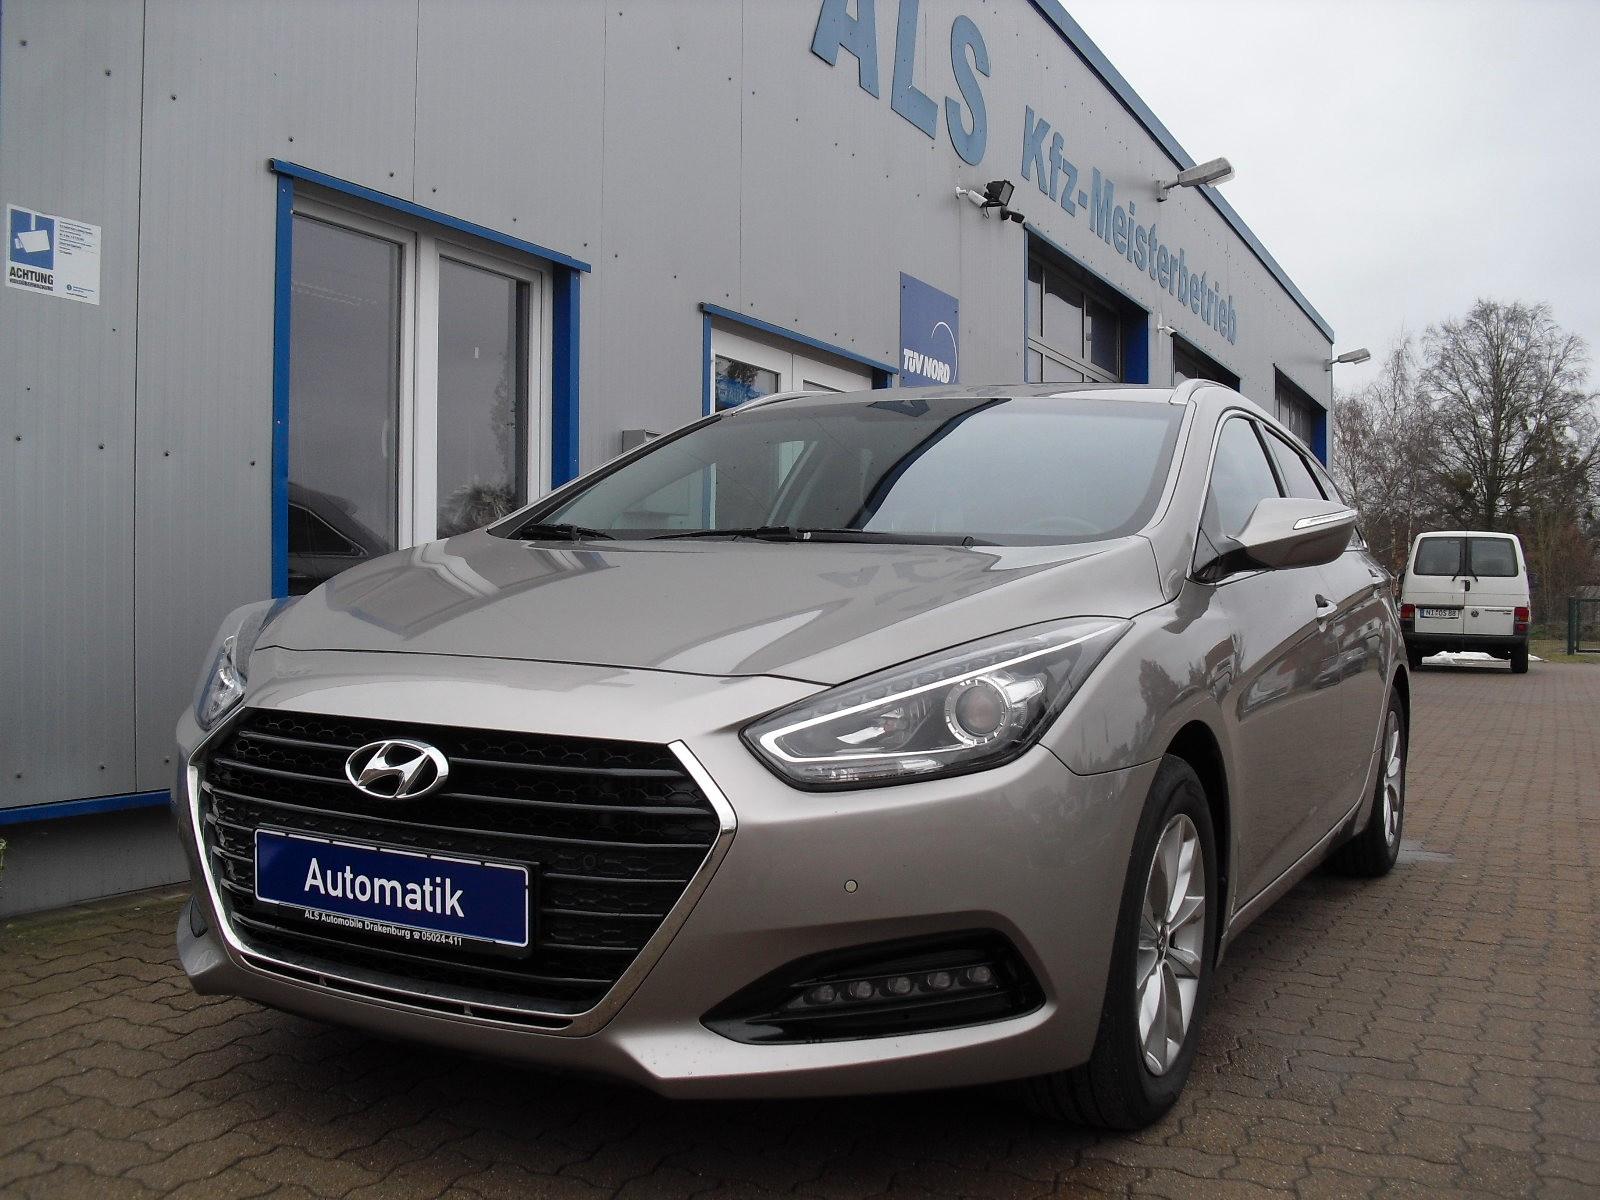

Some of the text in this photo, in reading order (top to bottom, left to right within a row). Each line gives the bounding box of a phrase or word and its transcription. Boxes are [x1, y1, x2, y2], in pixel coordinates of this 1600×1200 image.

[1021, 104, 1238, 346] Kfz-Meisterbetrieb
[10, 266, 54, 285] ACHTUNG
[903, 348, 950, 384] TÜV NORD
[304, 857, 464, 918] Automatik
[304, 909, 462, 946] ALS Automobile Drakenburg 05024-411
